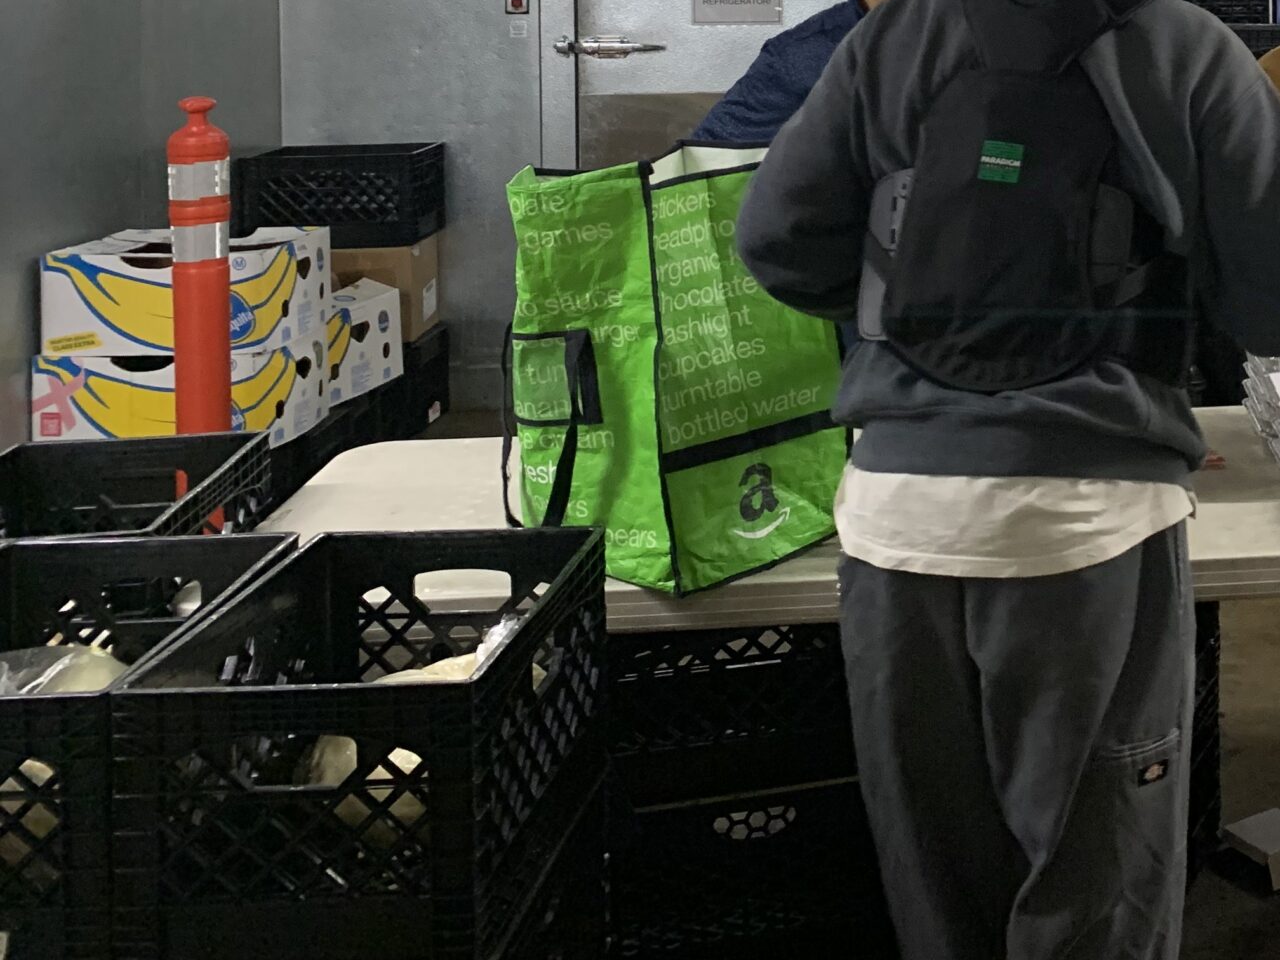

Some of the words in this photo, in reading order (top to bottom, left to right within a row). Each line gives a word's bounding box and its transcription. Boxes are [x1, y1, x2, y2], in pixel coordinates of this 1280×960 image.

[523, 221, 615, 256] games
[543, 288, 624, 317] sauce
[658, 337, 767, 381] cupcakes
[661, 367, 763, 413] turntable
[667, 401, 750, 445] bottled
[752, 385, 822, 418] water
[538, 429, 616, 450] cram
[738, 462, 780, 522] a
